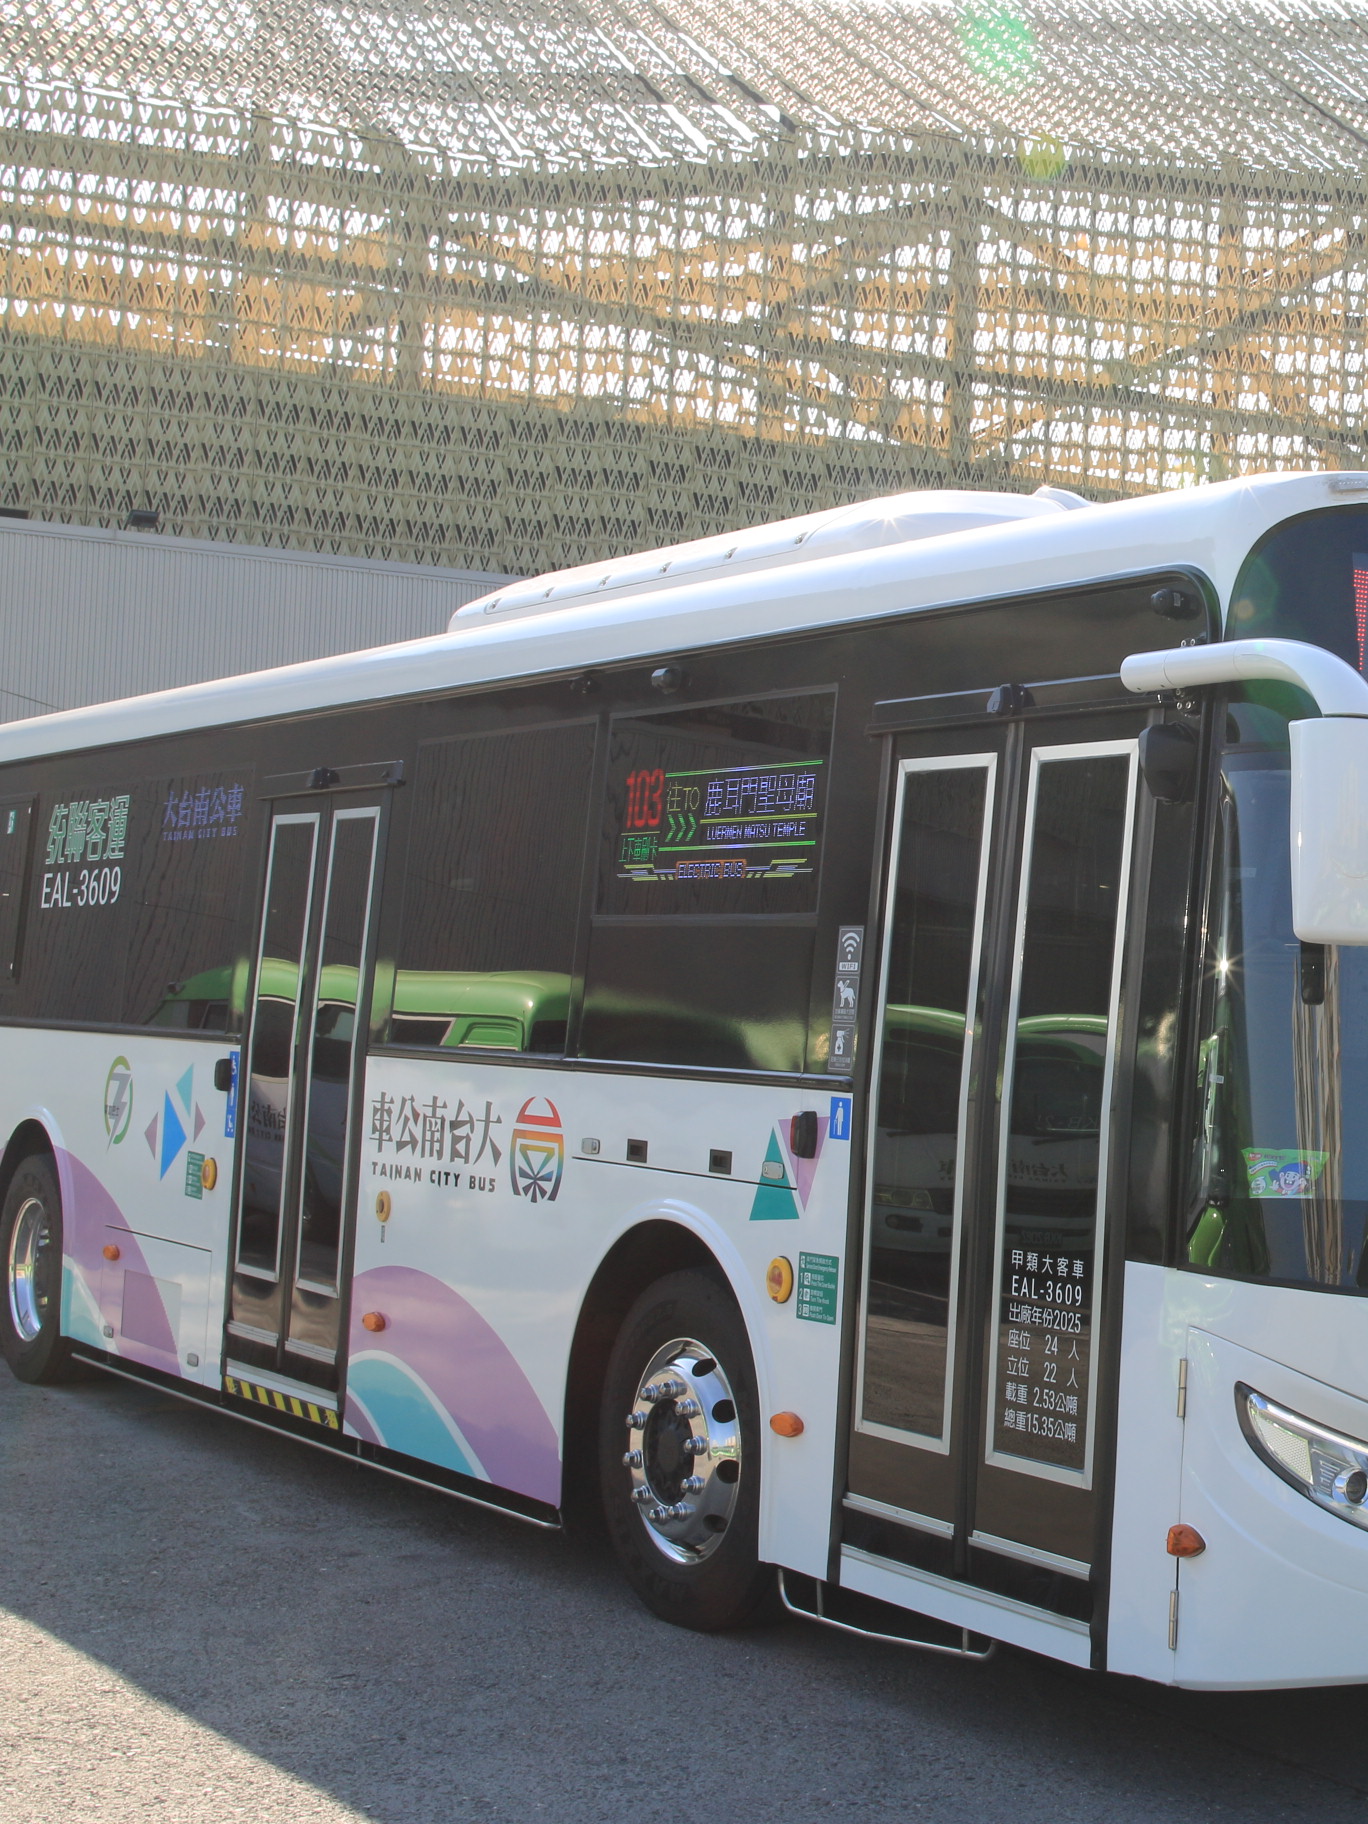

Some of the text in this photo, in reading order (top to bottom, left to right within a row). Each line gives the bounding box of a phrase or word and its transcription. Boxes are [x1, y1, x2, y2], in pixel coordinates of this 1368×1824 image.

[162, 783, 244, 828] 大台南公車
[626, 768, 665, 828] 103
[704, 771, 817, 816] 鹿耳門聖母廟
[45, 795, 130, 865] 統聯客運
[163, 825, 239, 842] TAINAN CITY BUS
[707, 822, 806, 841] LUERMEN MATSU TEMPLE
[677, 861, 743, 879] ELECTRIC BUS
[41, 866, 121, 909] EAL-3609
[371, 1161, 497, 1193] TAINAN CITY BUS
[1011, 1249, 1084, 1280] 甲類大客車
[1012, 1275, 1083, 1307] EAL-3609
[1009, 1302, 1081, 1334] 出廠年份2025
[1008, 1328, 1080, 1361] 座位 24 人
[1006, 1354, 1079, 1389] 立位 22 人
[1005, 1381, 1028, 1405] 載重
